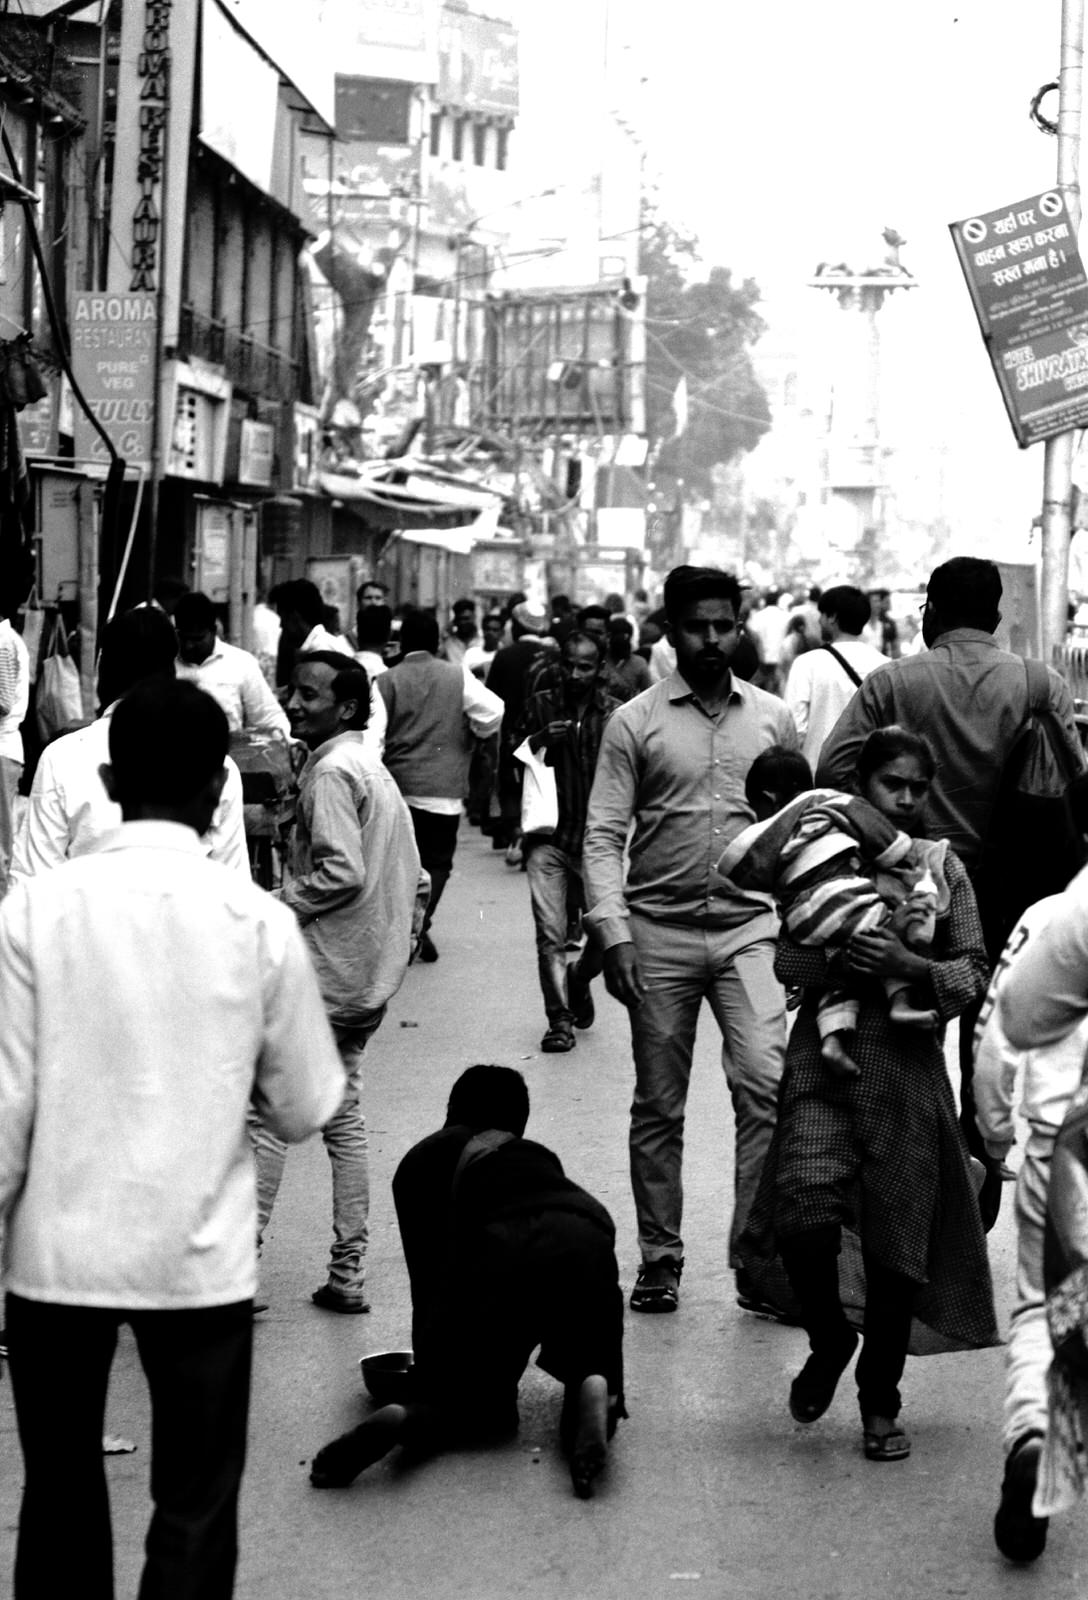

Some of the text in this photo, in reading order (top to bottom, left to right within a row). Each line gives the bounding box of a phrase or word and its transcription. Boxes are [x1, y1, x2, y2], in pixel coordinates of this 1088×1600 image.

[1016, 208, 1038, 226] पर
[973, 244, 1006, 267] वाहन
[1033, 223, 1070, 246] करना
[75, 298, 157, 321] AROMA
[97, 360, 140, 375] PURE
[101, 376, 136, 390] VEG
